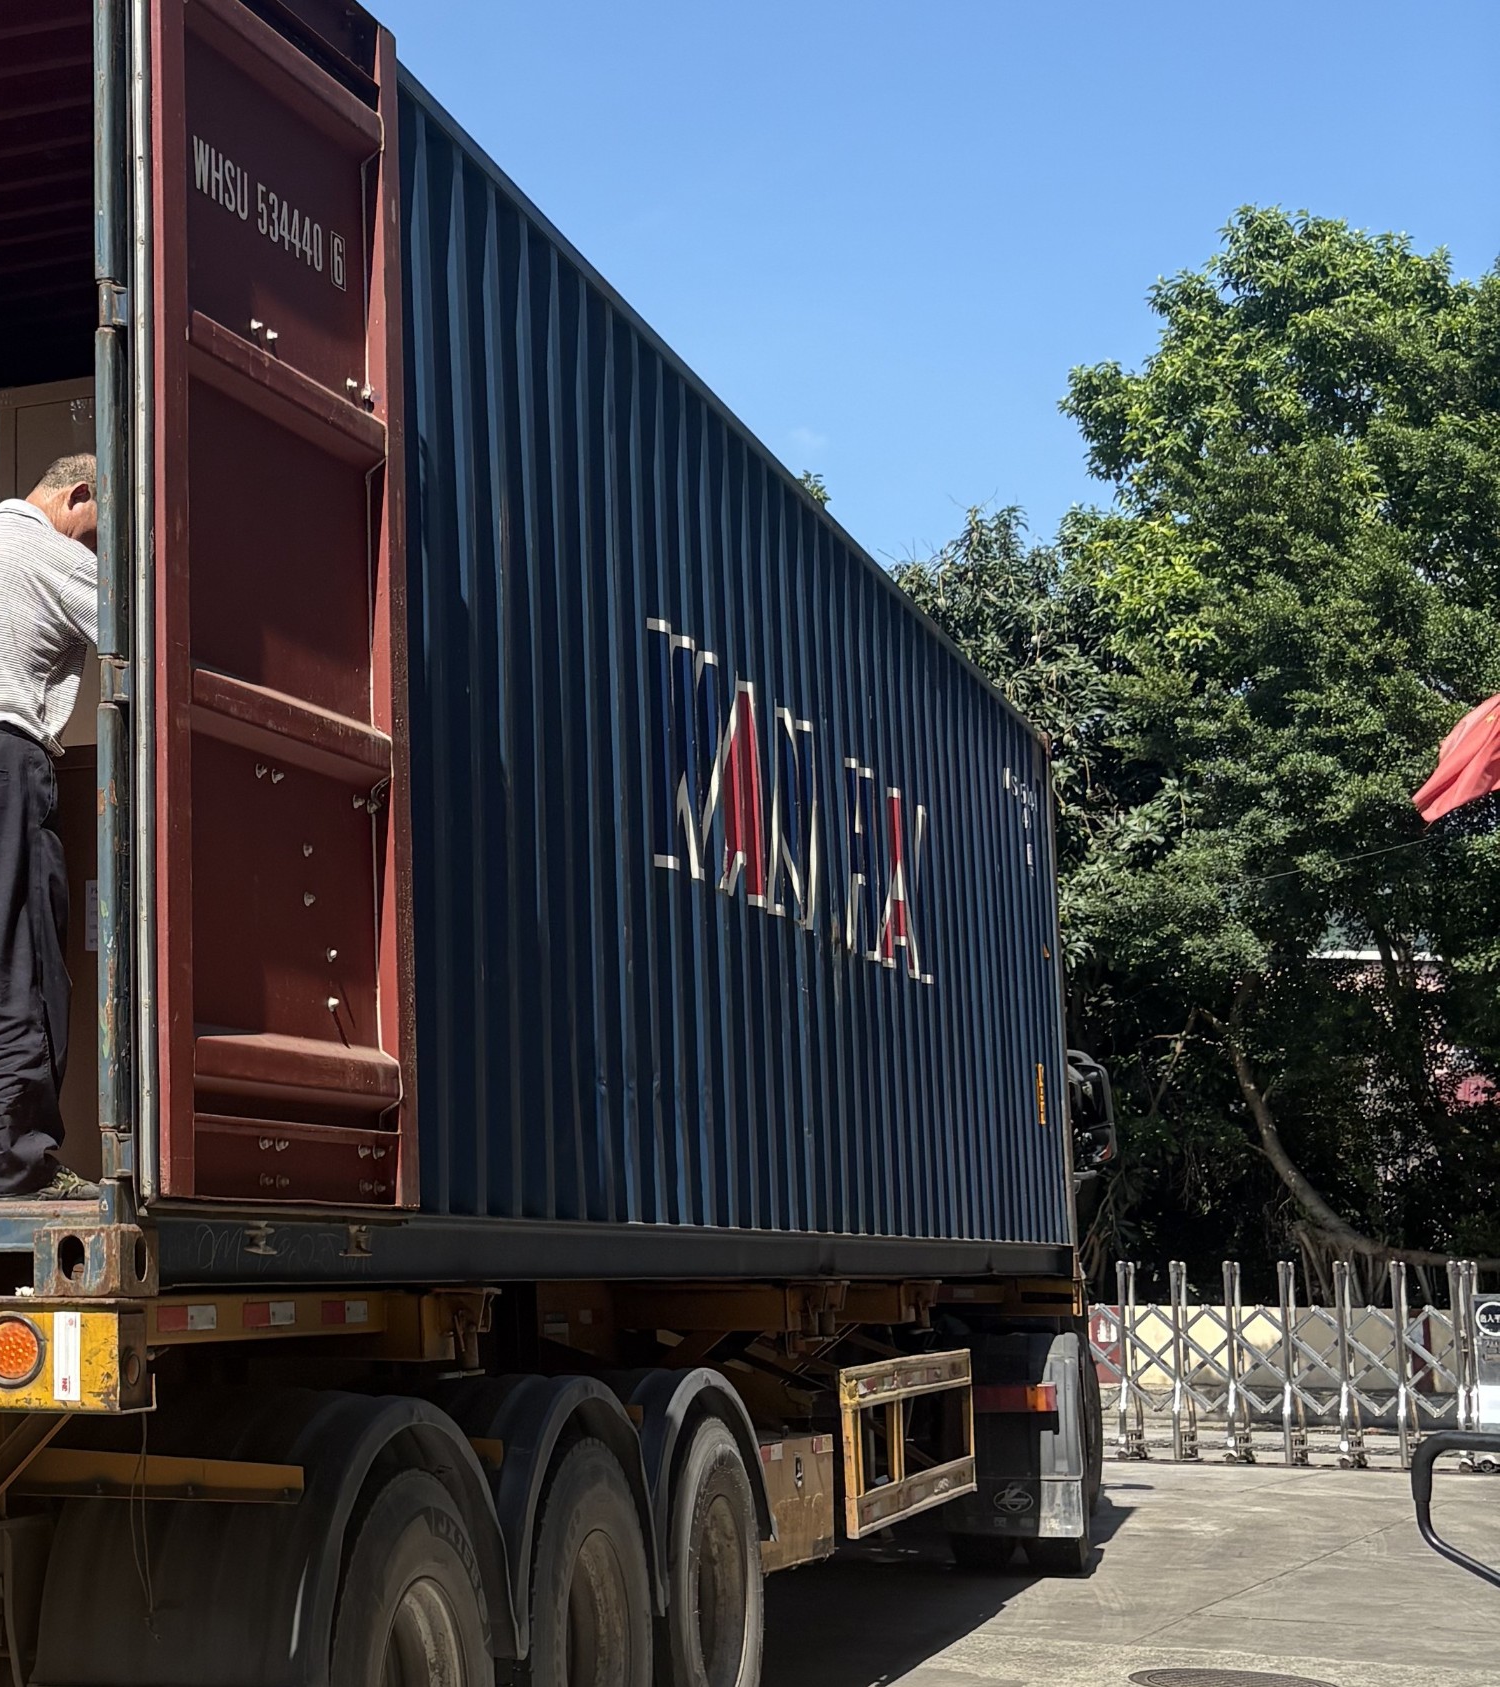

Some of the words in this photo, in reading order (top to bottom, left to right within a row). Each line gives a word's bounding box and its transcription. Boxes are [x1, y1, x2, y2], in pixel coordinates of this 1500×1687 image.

[192, 135, 248, 221] WHSU
[257, 182, 323, 272] 534440
[332, 234, 345, 288] 6
